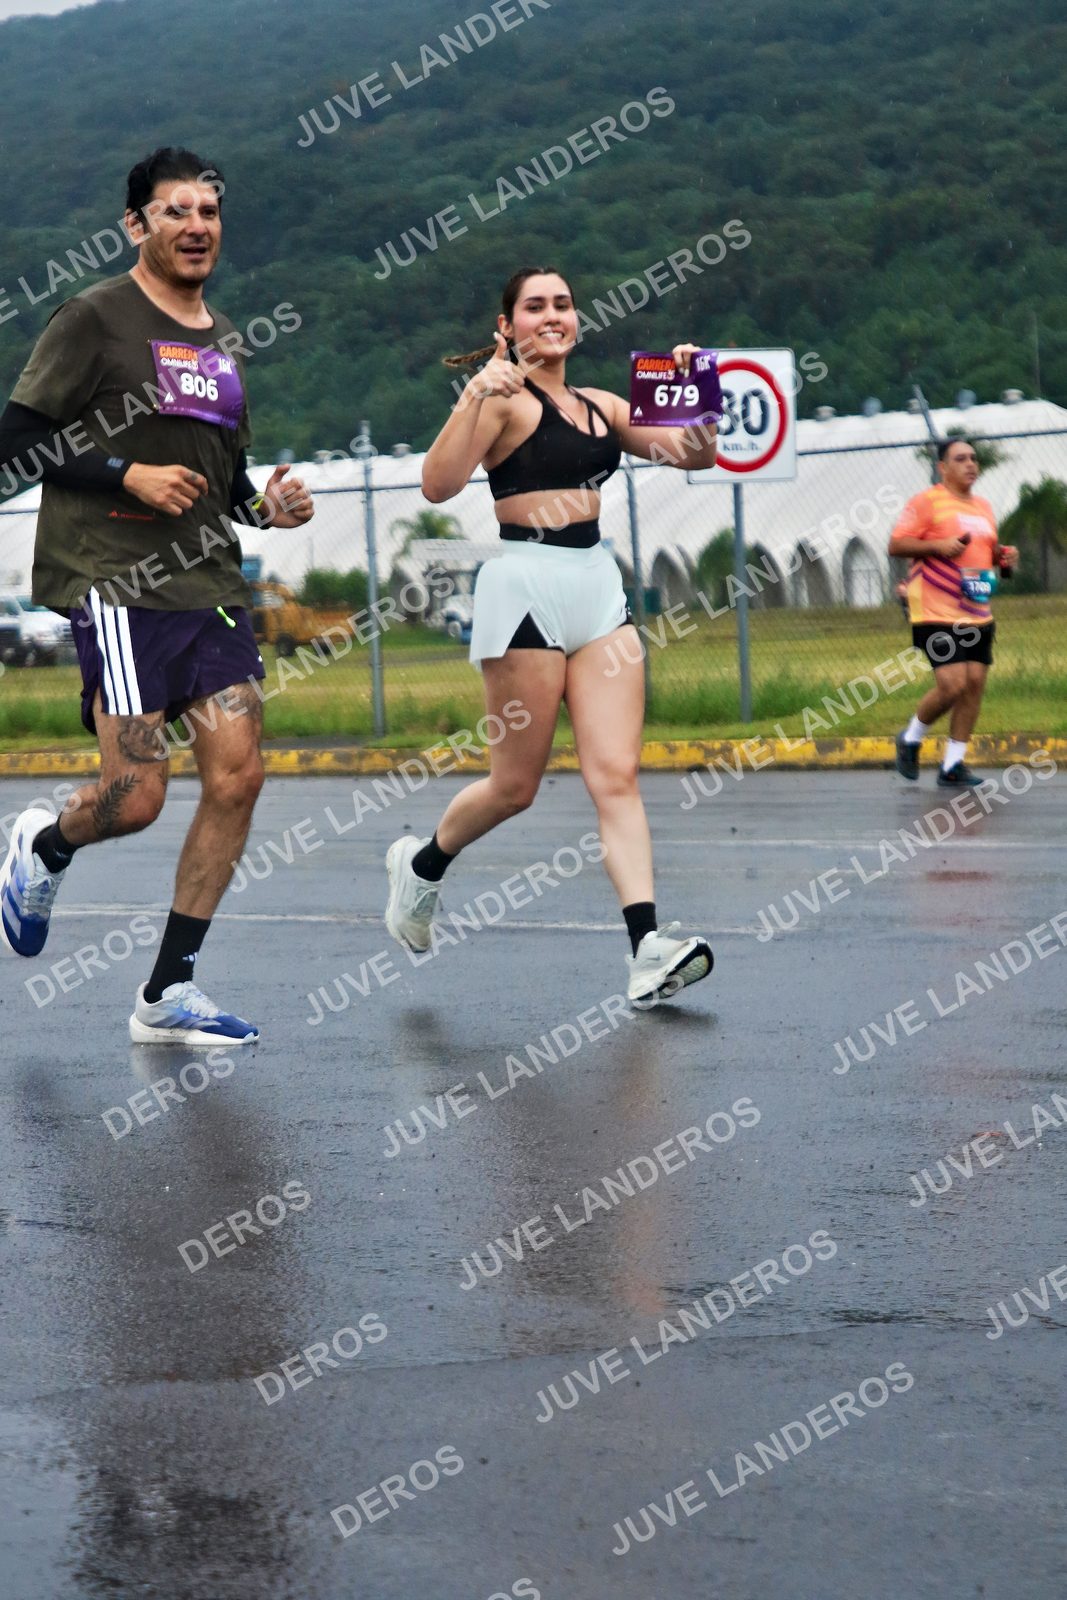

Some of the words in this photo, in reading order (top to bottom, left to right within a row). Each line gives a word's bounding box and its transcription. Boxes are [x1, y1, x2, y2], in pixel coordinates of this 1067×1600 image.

[159, 345, 198, 361] CARRERA
[636, 370, 667, 380] OMNILIFE
[180, 372, 218, 402] 806
[654, 384, 699, 407] 679
